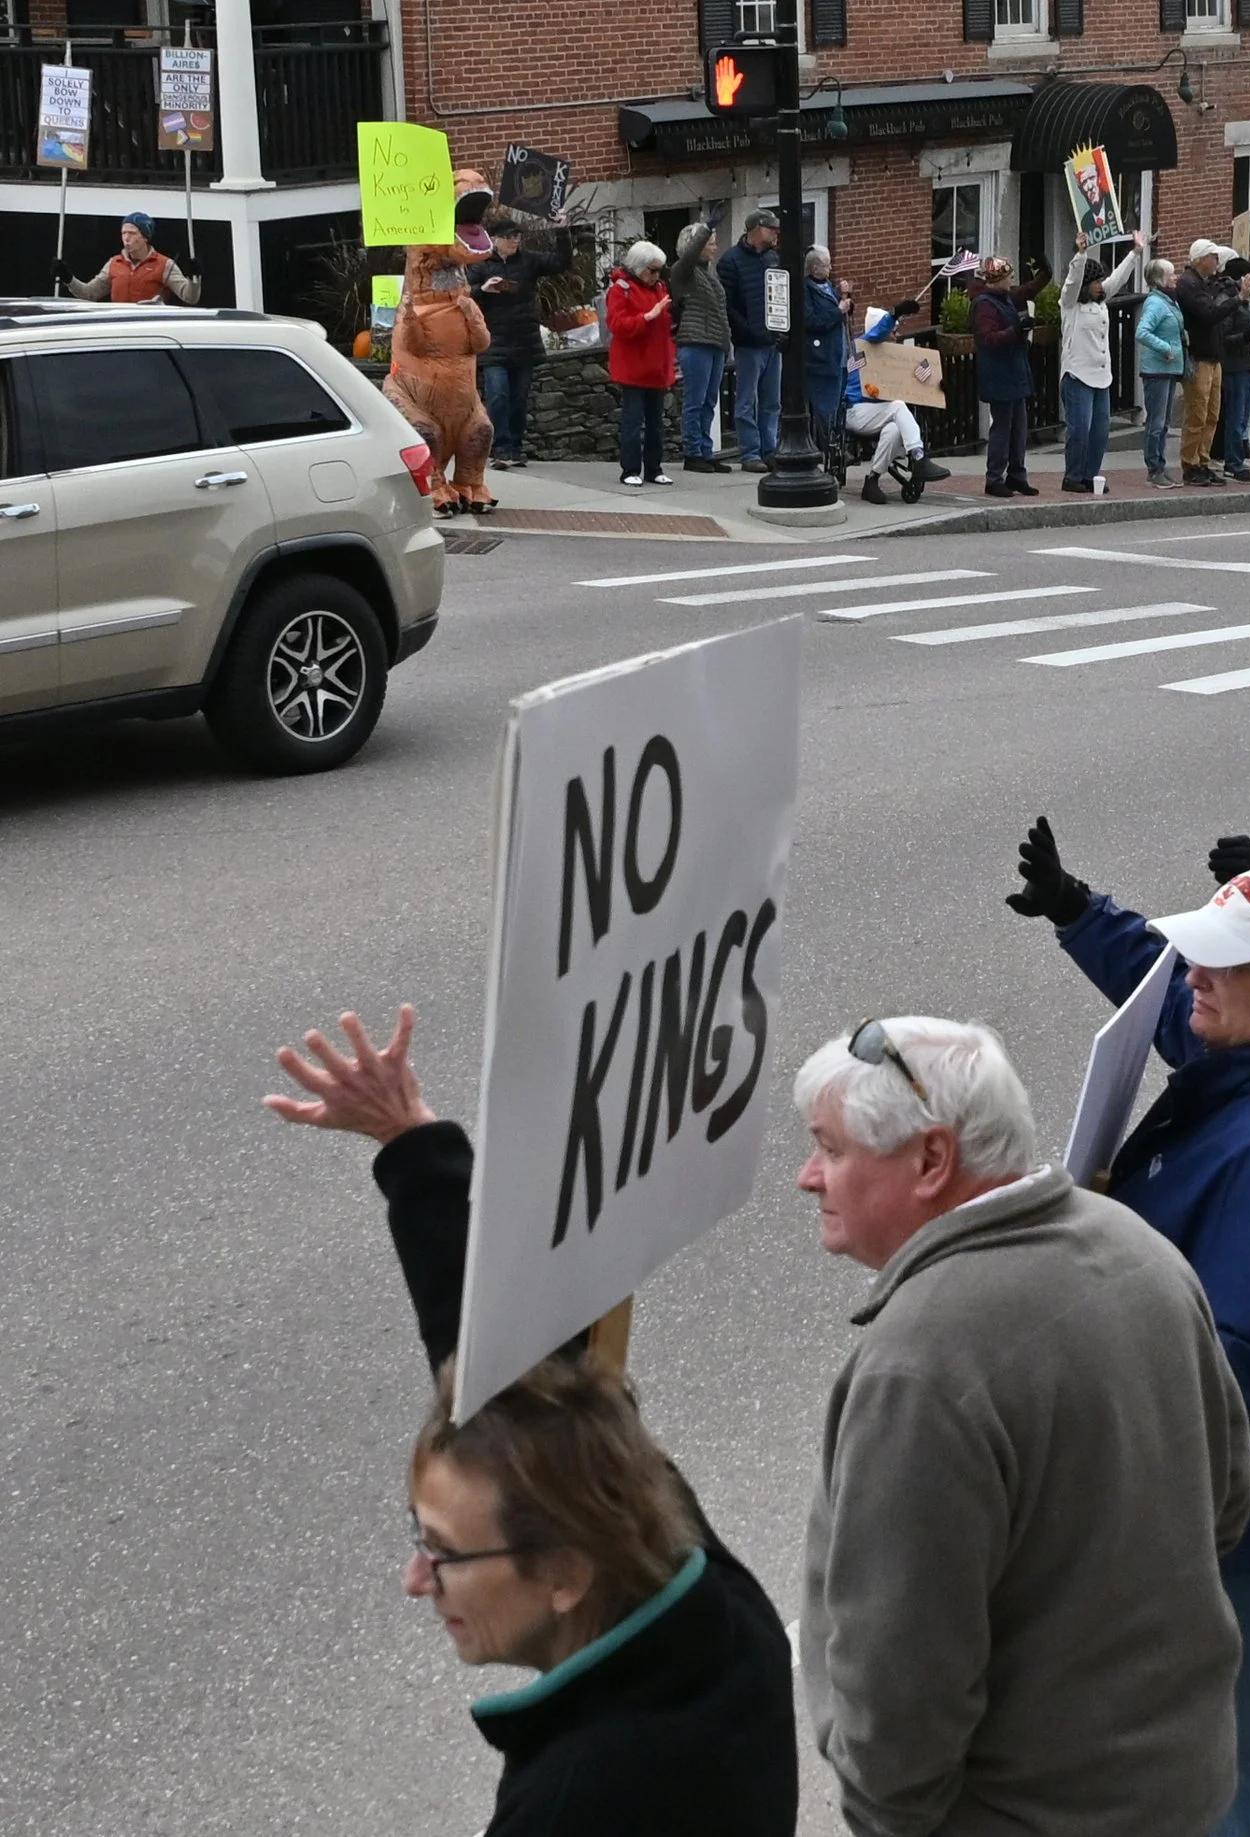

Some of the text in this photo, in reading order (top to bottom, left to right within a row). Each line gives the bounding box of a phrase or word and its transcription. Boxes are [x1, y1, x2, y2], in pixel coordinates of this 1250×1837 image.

[165, 50, 208, 59] BILLION-
[48, 78, 84, 89] SOLELY
[166, 74, 206, 83] ARE THE
[54, 87, 78, 97] BOW
[172, 84, 199, 93] ONLY
[49, 96, 81, 107] DOWN
[59, 107, 71, 116] TO
[44, 115, 85, 128] QUEENS
[372, 134, 408, 168] No
[507, 144, 528, 165] NO
[373, 172, 416, 200] Kings
[548, 161, 568, 222] KINGS
[1085, 220, 1118, 246] NOPE
[556, 733, 682, 979] NO
[551, 898, 777, 1250] KINGS
